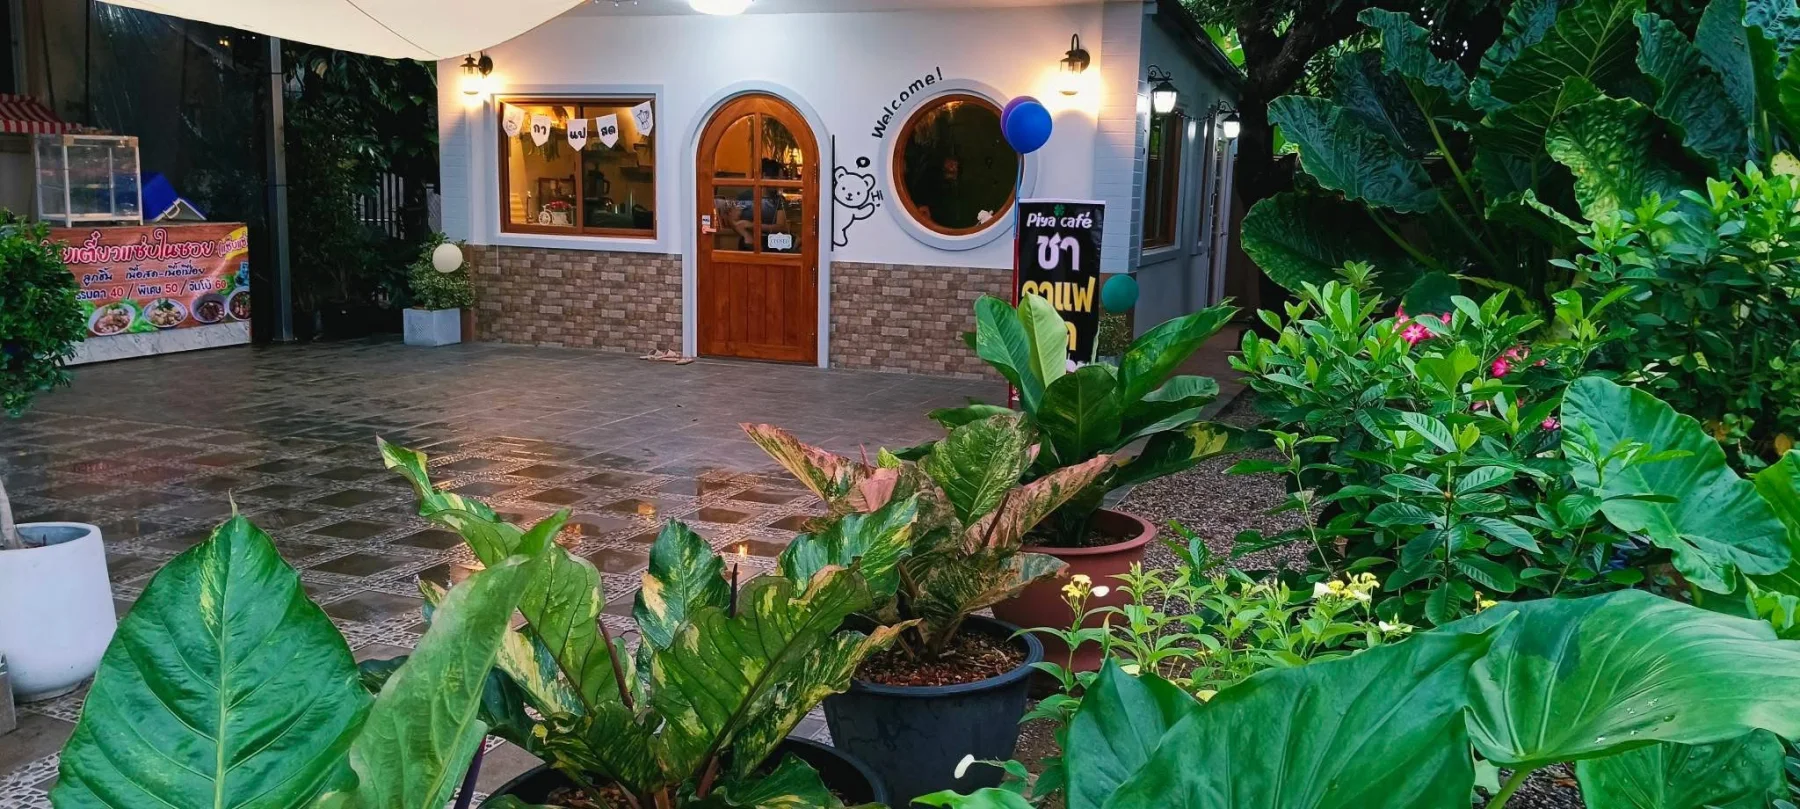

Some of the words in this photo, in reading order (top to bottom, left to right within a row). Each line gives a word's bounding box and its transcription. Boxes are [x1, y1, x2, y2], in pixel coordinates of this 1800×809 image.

[871, 66, 943, 139] Welcome!
[533, 123, 547, 136] กา
[1026, 212, 1056, 228] Piya
[1060, 211, 1093, 229] café
[1037, 232, 1081, 272] ชา
[75, 289, 108, 301] รรมดา
[109, 286, 124, 298] 40
[165, 282, 178, 293] 50
[215, 278, 227, 290] 60
